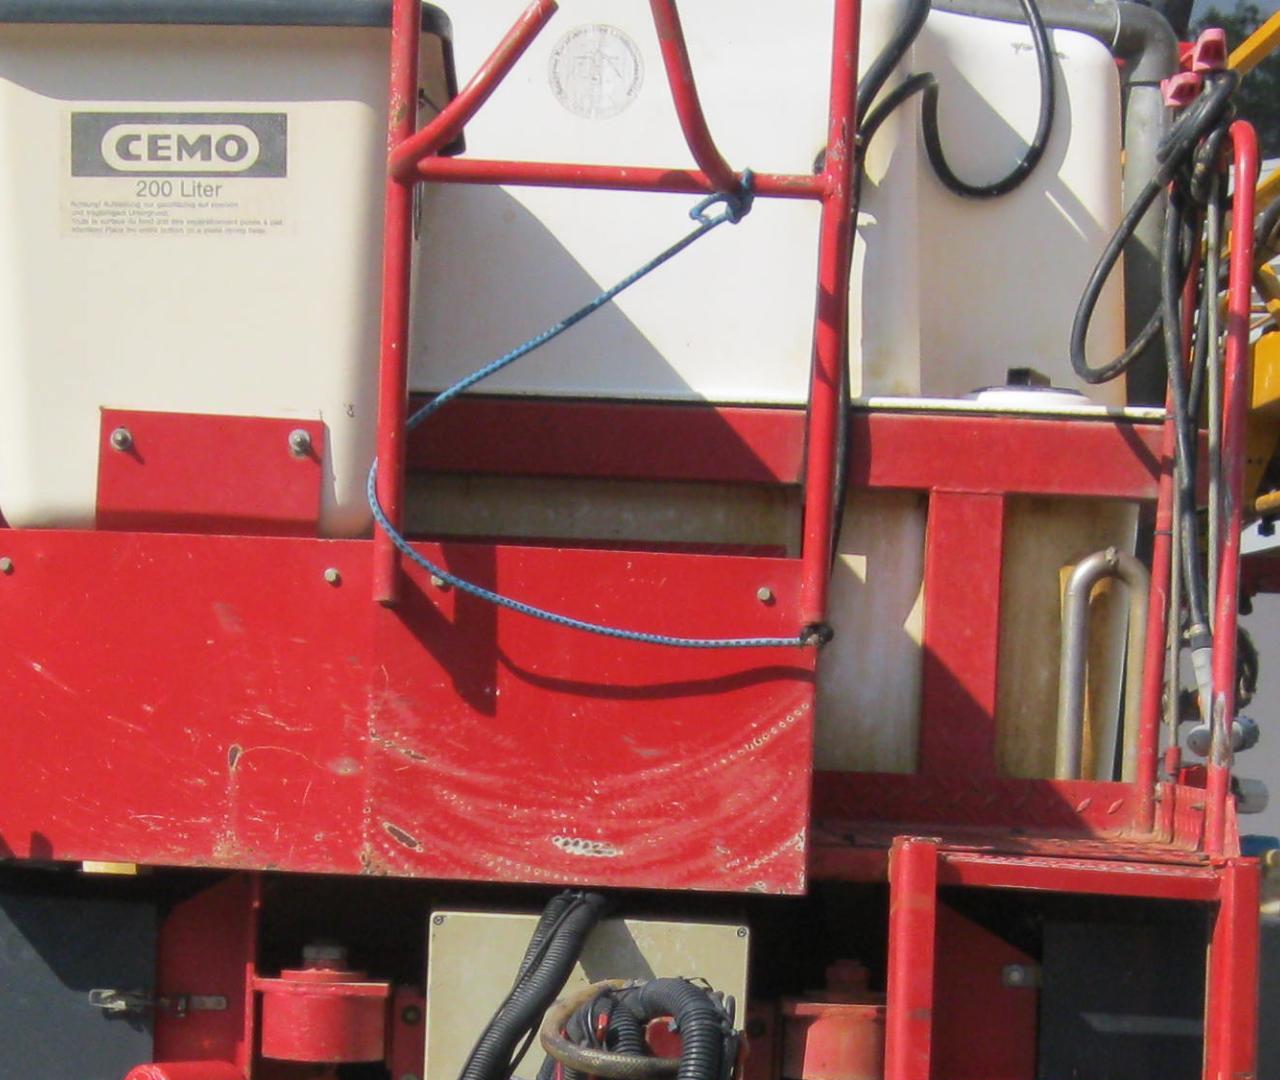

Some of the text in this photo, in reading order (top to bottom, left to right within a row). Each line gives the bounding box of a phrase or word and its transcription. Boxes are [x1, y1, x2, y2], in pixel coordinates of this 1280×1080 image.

[115, 133, 249, 162] CEMO
[136, 180, 223, 198] 200 Liter
